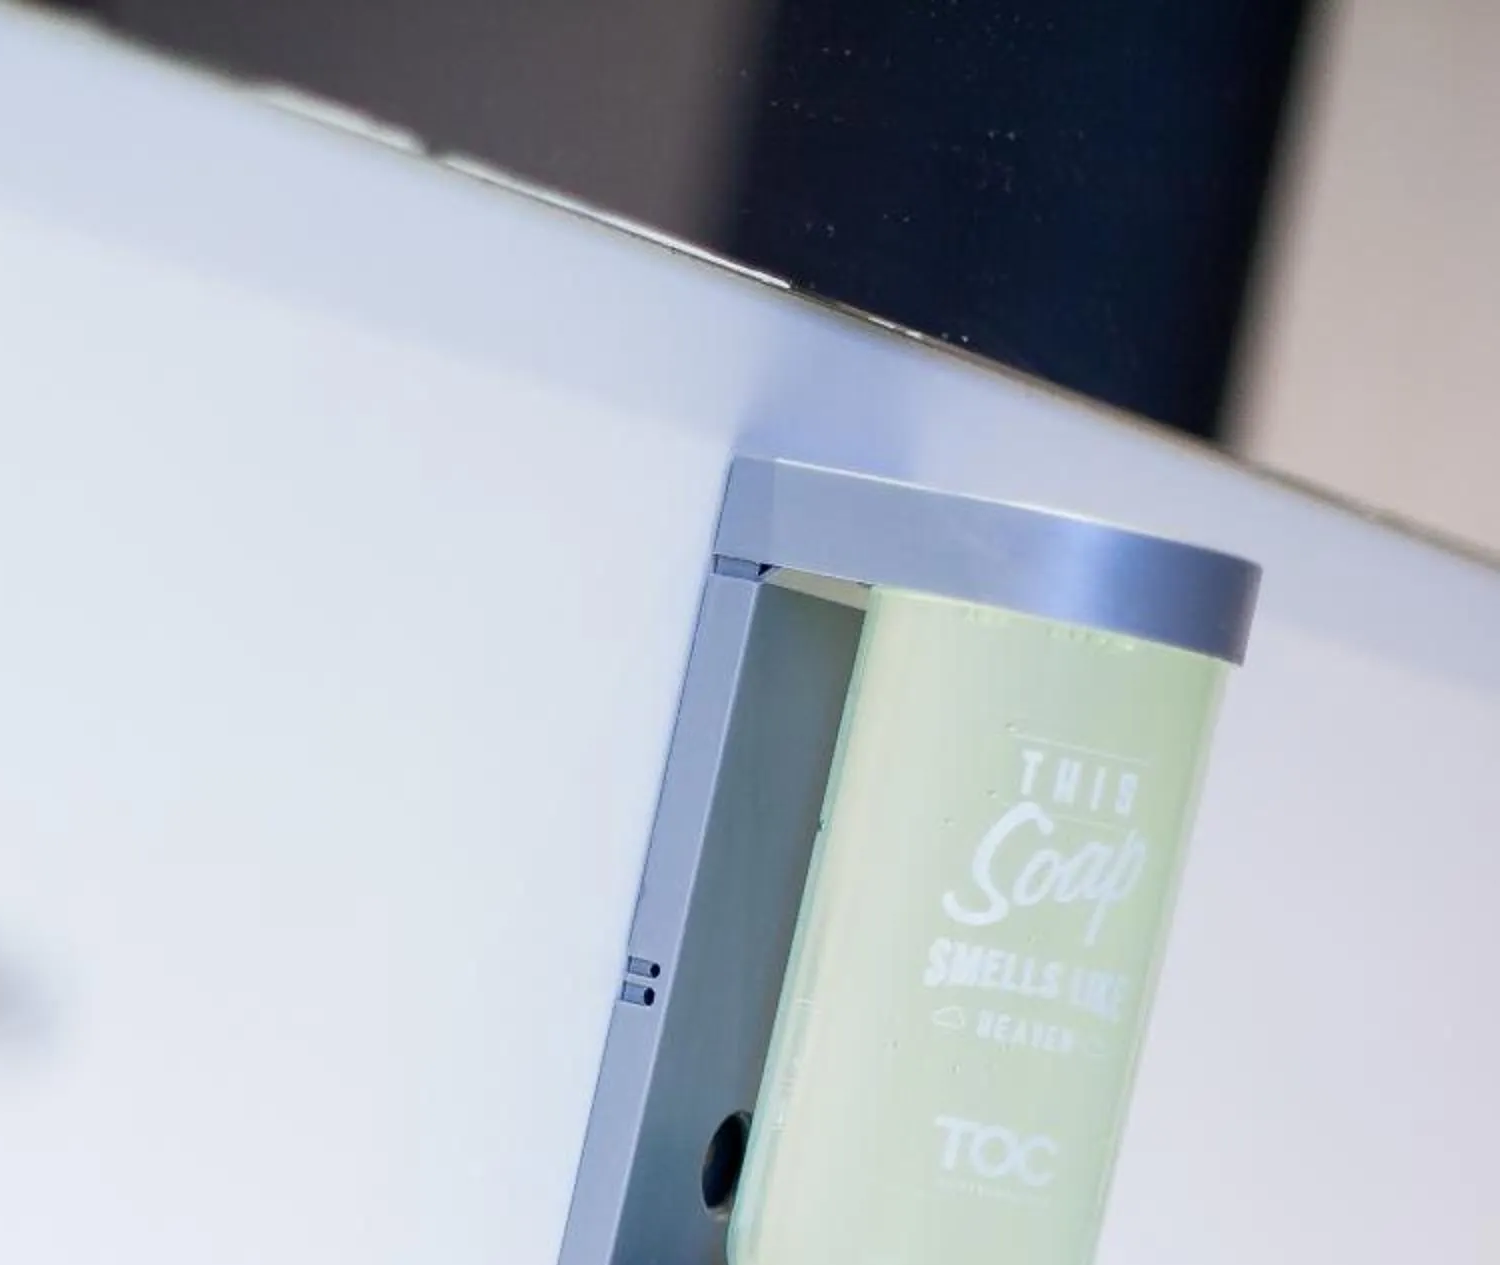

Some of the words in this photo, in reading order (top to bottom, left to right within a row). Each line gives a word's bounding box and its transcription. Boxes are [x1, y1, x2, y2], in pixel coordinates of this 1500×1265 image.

[1021, 749, 1139, 816] THIS
[941, 801, 1147, 947] Soap
[922, 936, 1064, 999] SMELLS
[934, 1114, 1059, 1187] TOC
